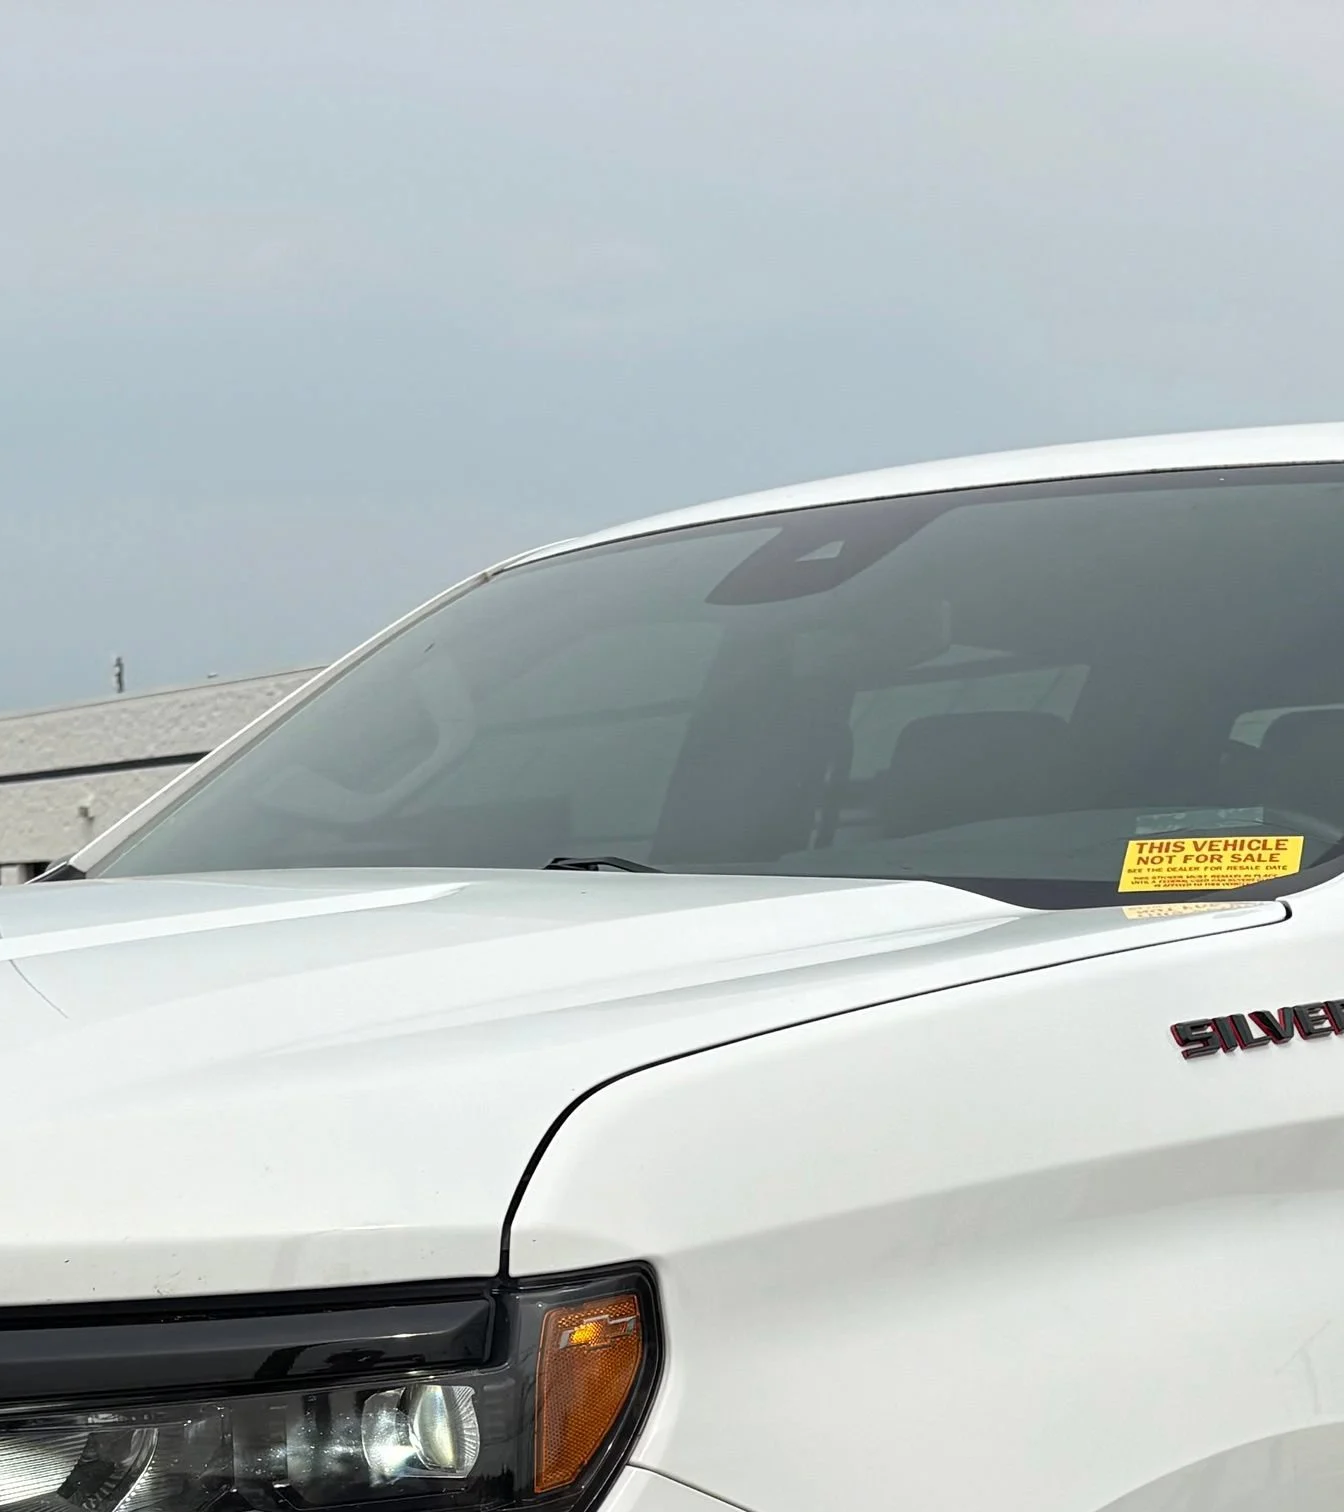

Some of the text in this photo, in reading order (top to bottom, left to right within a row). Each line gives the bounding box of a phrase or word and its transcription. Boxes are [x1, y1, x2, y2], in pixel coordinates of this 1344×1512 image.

[1136, 839, 1289, 854] THIS VEHICLE
[1136, 853, 1281, 865] NOT FOR SALE
